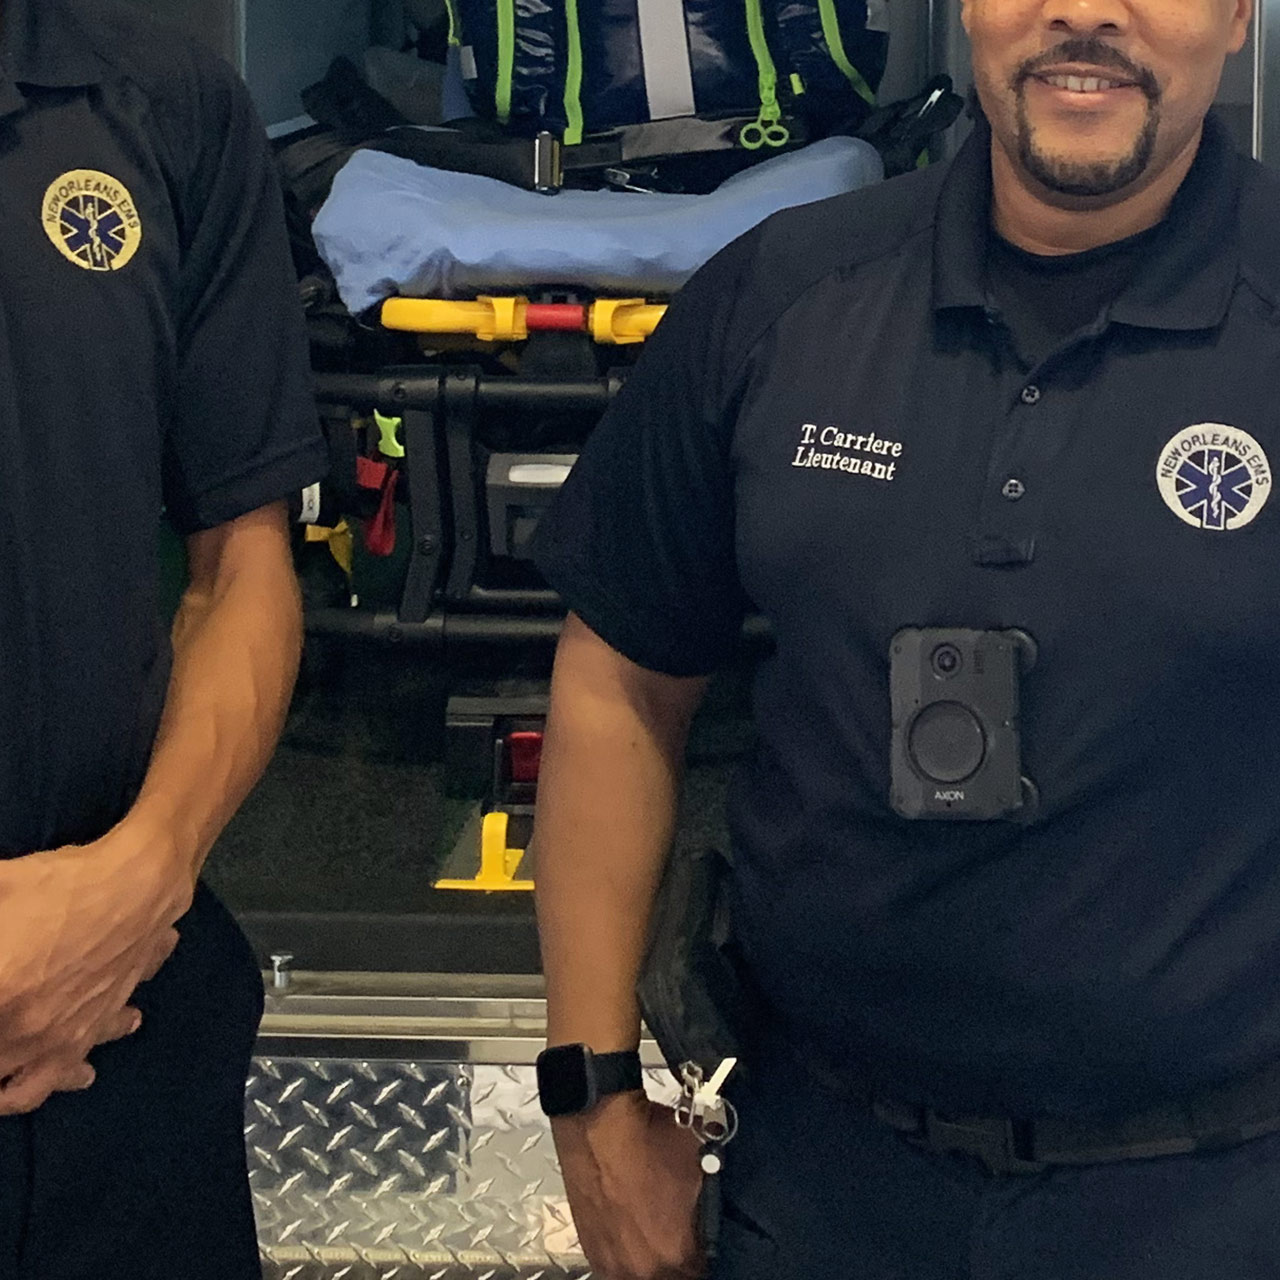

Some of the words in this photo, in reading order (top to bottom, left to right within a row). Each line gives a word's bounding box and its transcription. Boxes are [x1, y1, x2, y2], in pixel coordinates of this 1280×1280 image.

[58, 179, 120, 202] ORLEANS
[116, 199, 139, 229] EMS
[801, 423, 817, 444] T.
[820, 426, 903, 457] Carriere
[791, 446, 896, 481] Lieutenant
[1160, 447, 1182, 479] NEW
[1180, 433, 1252, 457] ORLEANS
[1246, 454, 1270, 486] EMS
[934, 790, 965, 801] AXON
